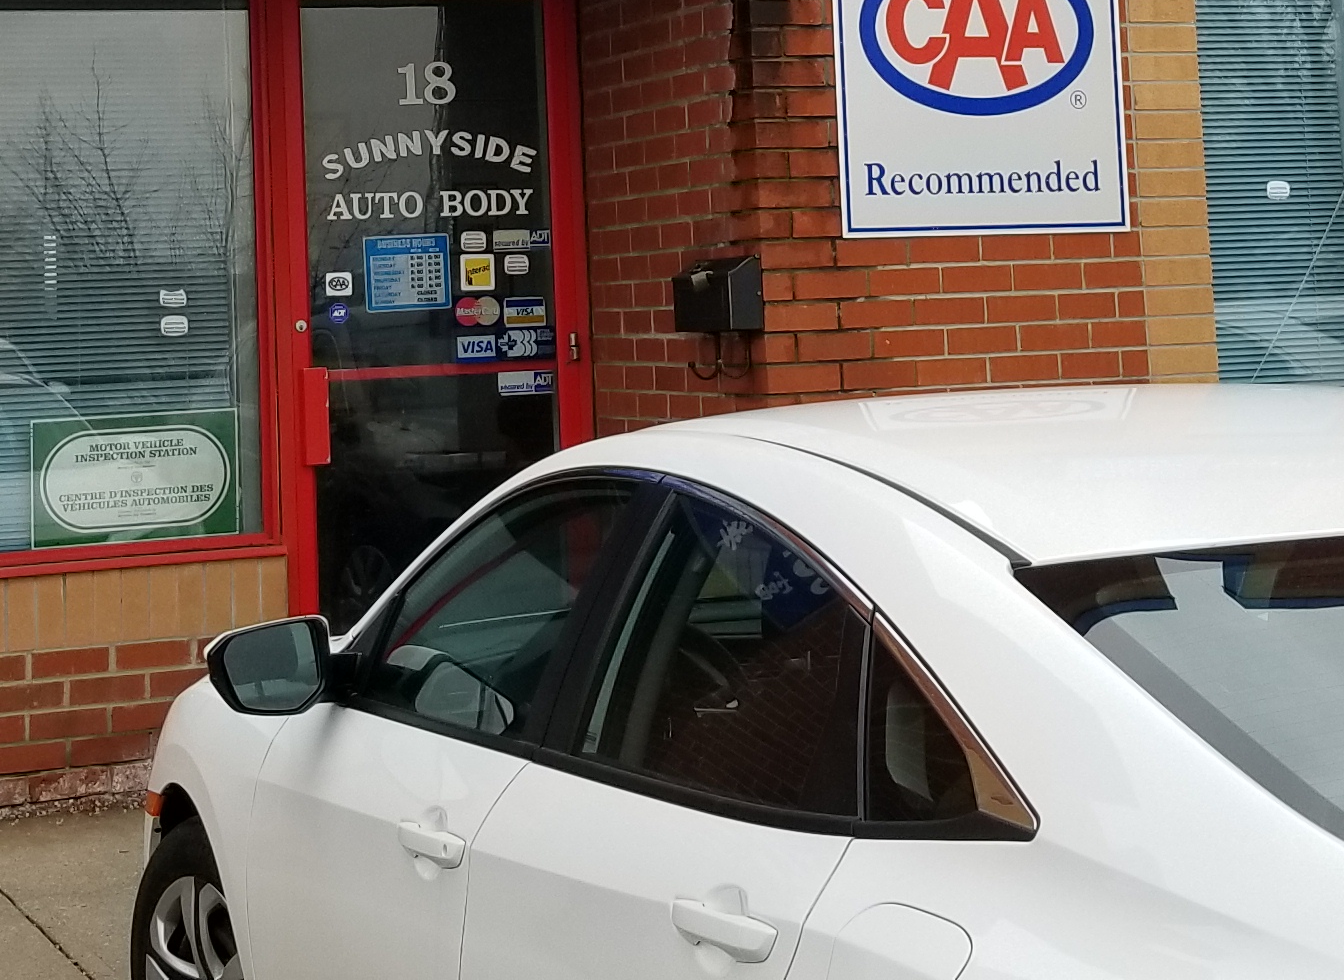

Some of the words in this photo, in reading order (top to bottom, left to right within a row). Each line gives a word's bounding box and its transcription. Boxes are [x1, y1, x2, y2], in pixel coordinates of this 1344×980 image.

[397, 60, 457, 106] 18
[321, 129, 537, 180] SUNNYSIDE
[863, 159, 1101, 196] Recommended
[326, 191, 424, 221] AUTO
[439, 188, 534, 217] BODY
[516, 307, 535, 316] VISA
[462, 340, 493, 354] VISA
[74, 450, 147, 463] INSPECTION
[148, 446, 198, 458] STATION
[89, 441, 131, 453] MOTOR
[133, 438, 184, 450] VEHICLE
[58, 491, 106, 503] CENTRE
[109, 485, 189, 499] D'INSPECTION
[191, 483, 214, 494] DES
[130, 493, 211, 508] AUTOMOBILES
